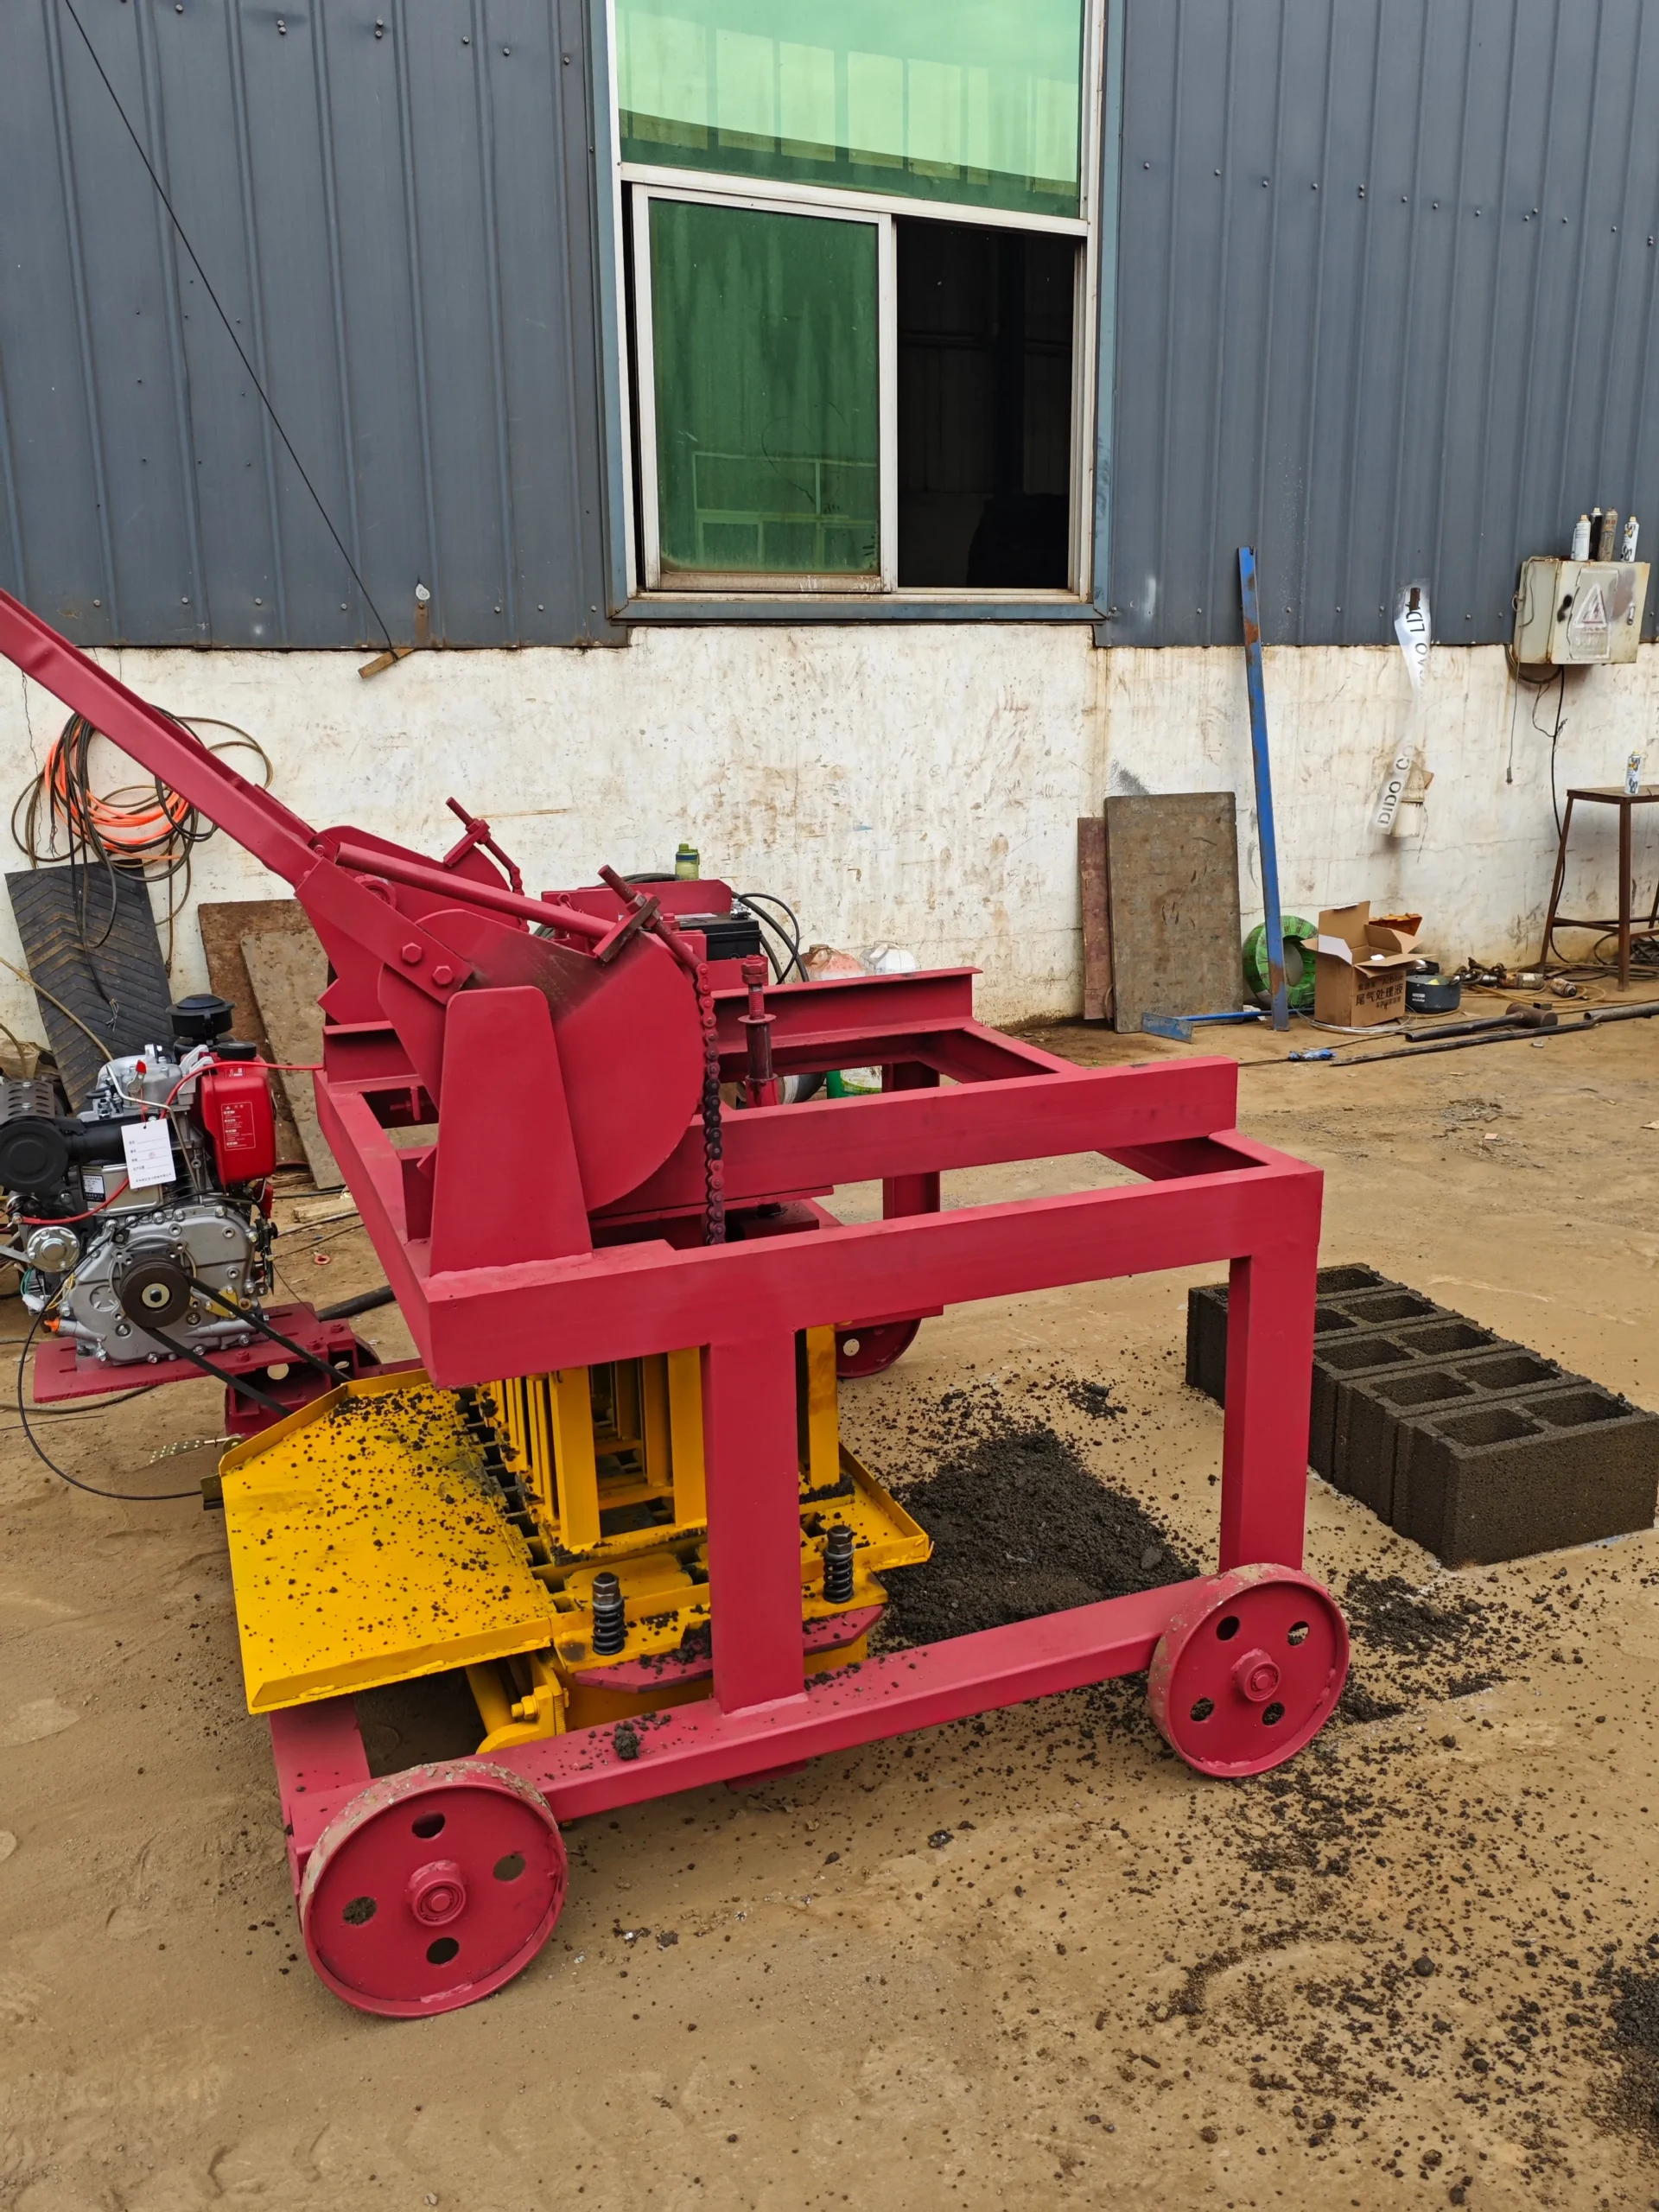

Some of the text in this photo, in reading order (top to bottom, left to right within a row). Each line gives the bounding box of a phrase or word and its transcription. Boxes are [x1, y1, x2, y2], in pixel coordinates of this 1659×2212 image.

[1355, 983, 1403, 1006] 尾气处理液
